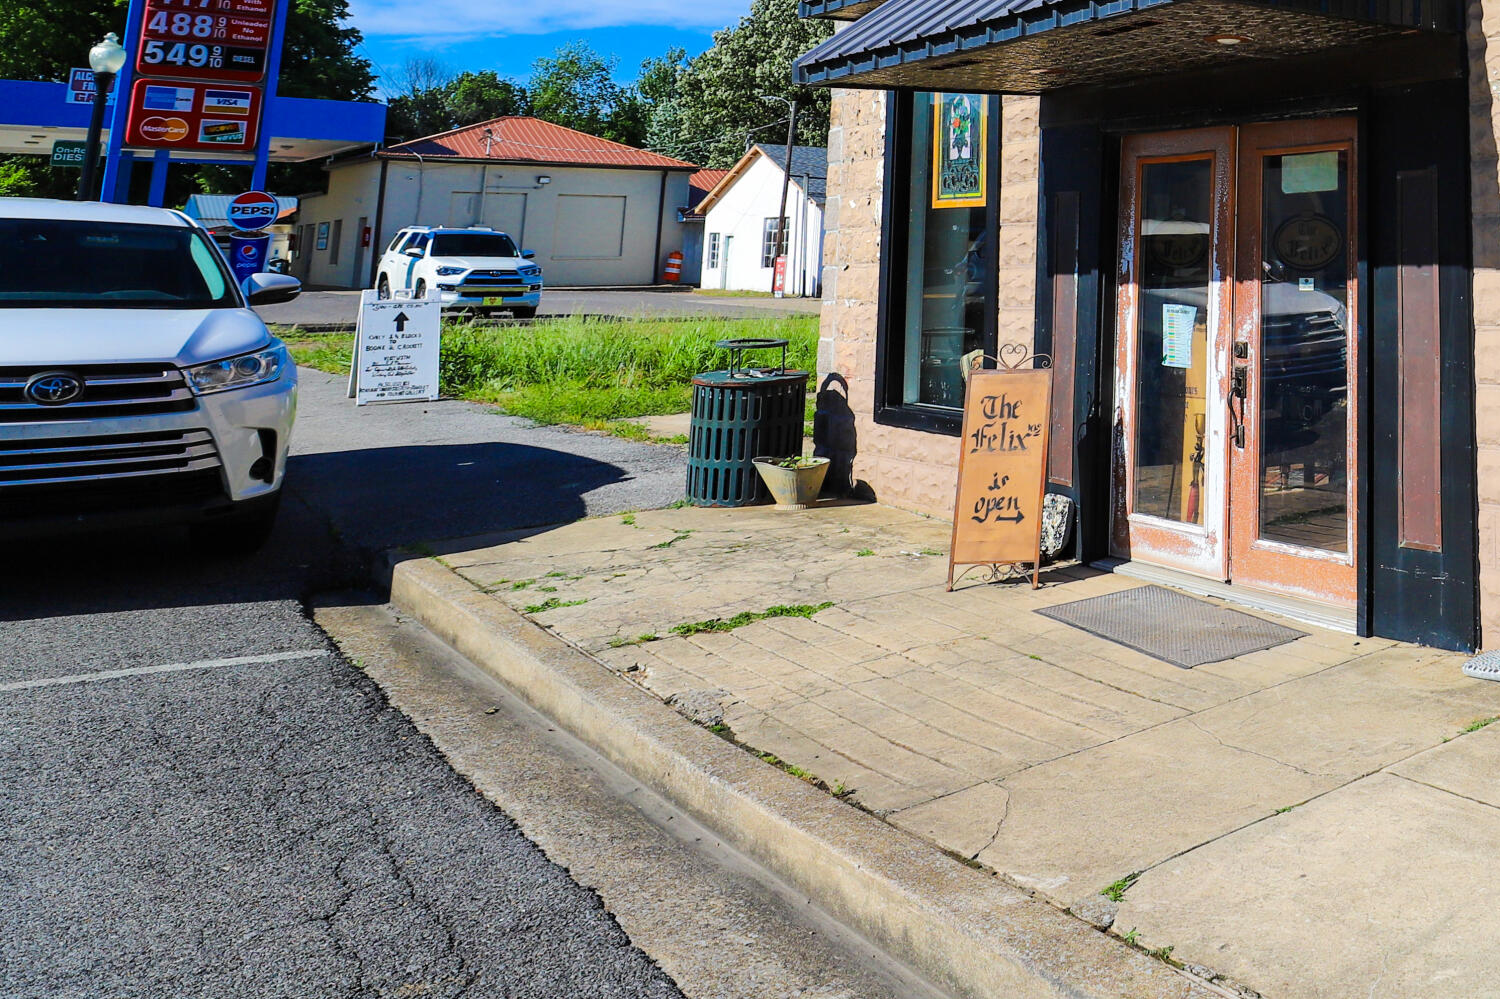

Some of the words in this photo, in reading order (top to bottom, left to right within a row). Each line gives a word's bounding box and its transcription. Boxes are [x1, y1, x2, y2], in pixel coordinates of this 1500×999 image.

[236, 4, 267, 13] Ethanol
[148, 11, 213, 38] 488
[231, 19, 268, 28] Unleaded
[232, 34, 263, 42] Ethanol
[143, 41, 209, 67] 549
[216, 98, 238, 106] VISA
[142, 125, 185, 134] MasterCard
[231, 206, 275, 215] PEPSI
[980, 391, 1023, 420] The
[970, 421, 1032, 454] Felix
[987, 471, 1010, 491] is
[971, 494, 1021, 524] open
